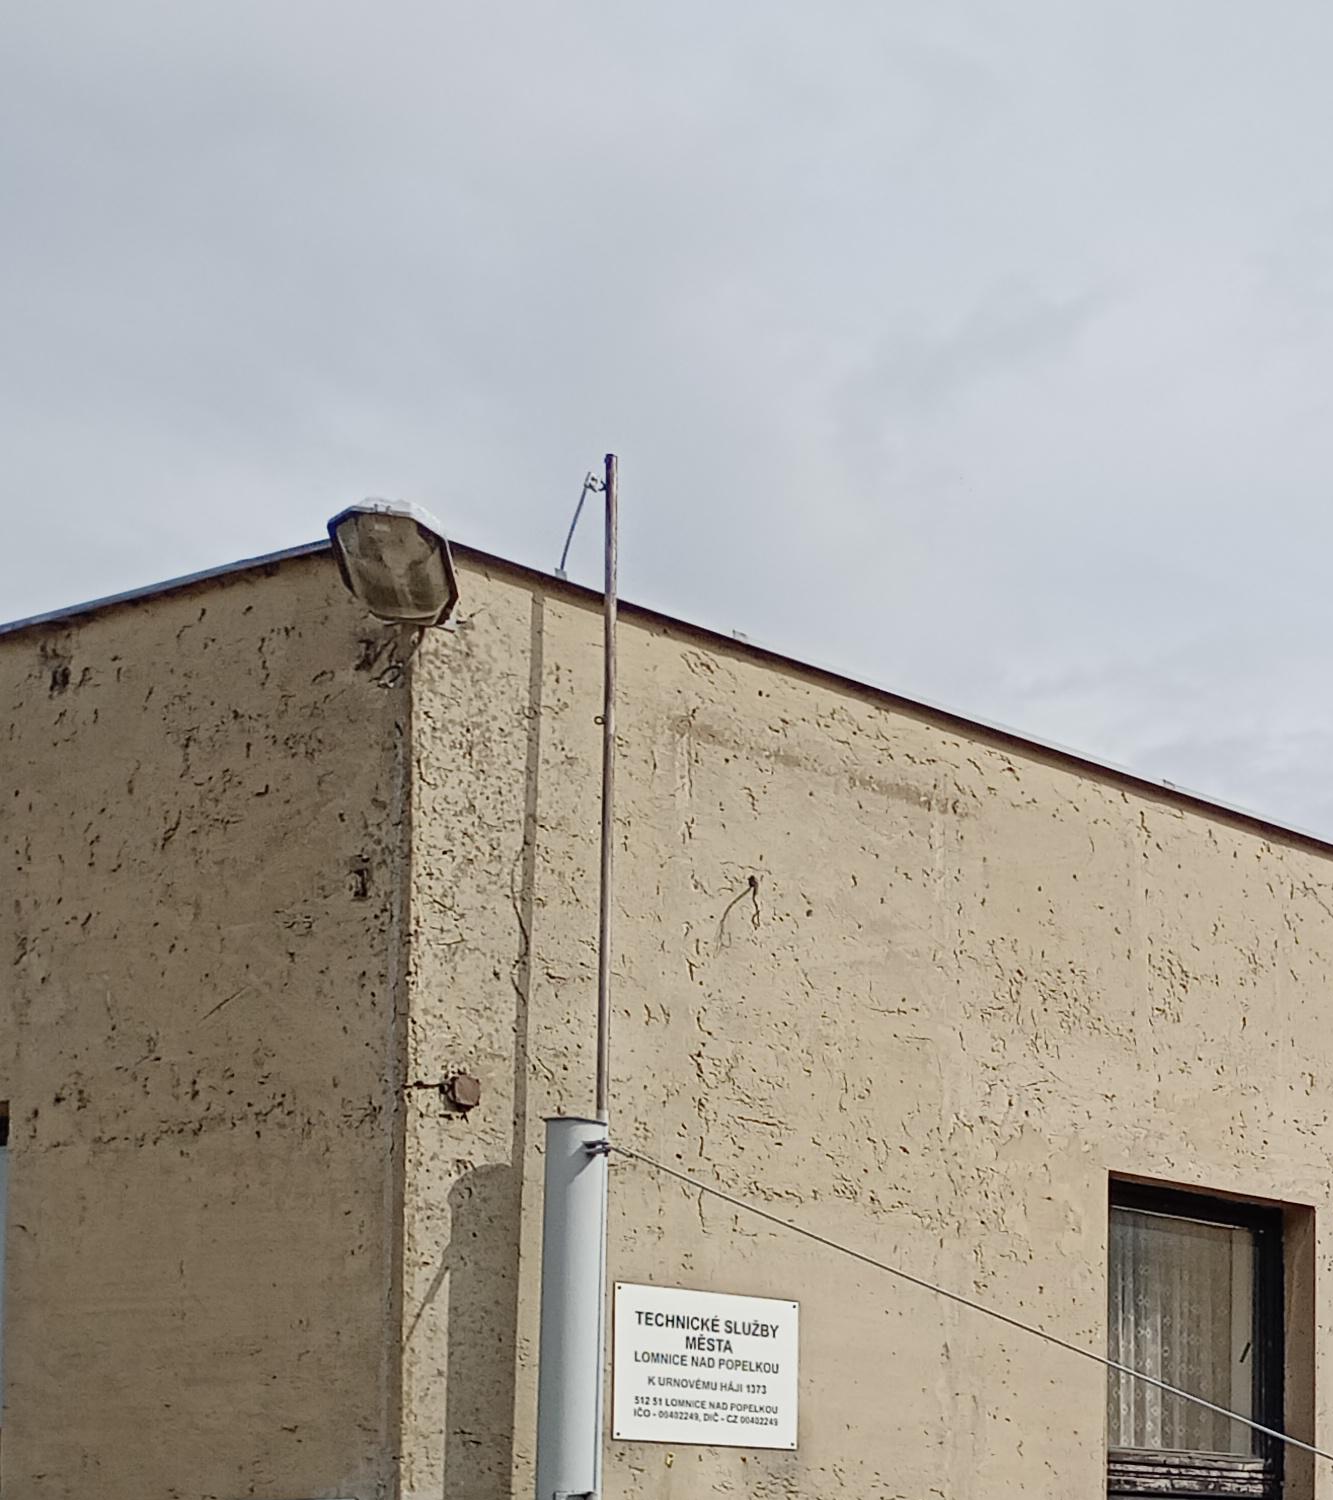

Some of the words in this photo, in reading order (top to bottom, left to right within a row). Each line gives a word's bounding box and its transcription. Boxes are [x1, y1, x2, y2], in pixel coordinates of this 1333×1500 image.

[635, 1310, 720, 1333] TECHNICKÉ
[724, 1319, 779, 1339] SLUŽBY
[685, 1333, 733, 1354] MĚSTA
[634, 1350, 688, 1367] LOMNICE
[691, 1355, 715, 1369] NAD
[718, 1357, 779, 1375] POPELKOU
[647, 1375, 656, 1386] K
[658, 1376, 718, 1392] URNOVÉMU
[720, 1380, 743, 1393] HÁJI
[633, 1406, 651, 1418] IČO
[703, 1411, 719, 1423] DIČ
[726, 1414, 739, 1424] CZ
[634, 1395, 650, 1406] 512
[652, 1396, 663, 1406] 51
[665, 1398, 707, 1410] LOMNICE
[709, 1401, 728, 1411] NAD
[730, 1402, 779, 1415] POPELKOU
